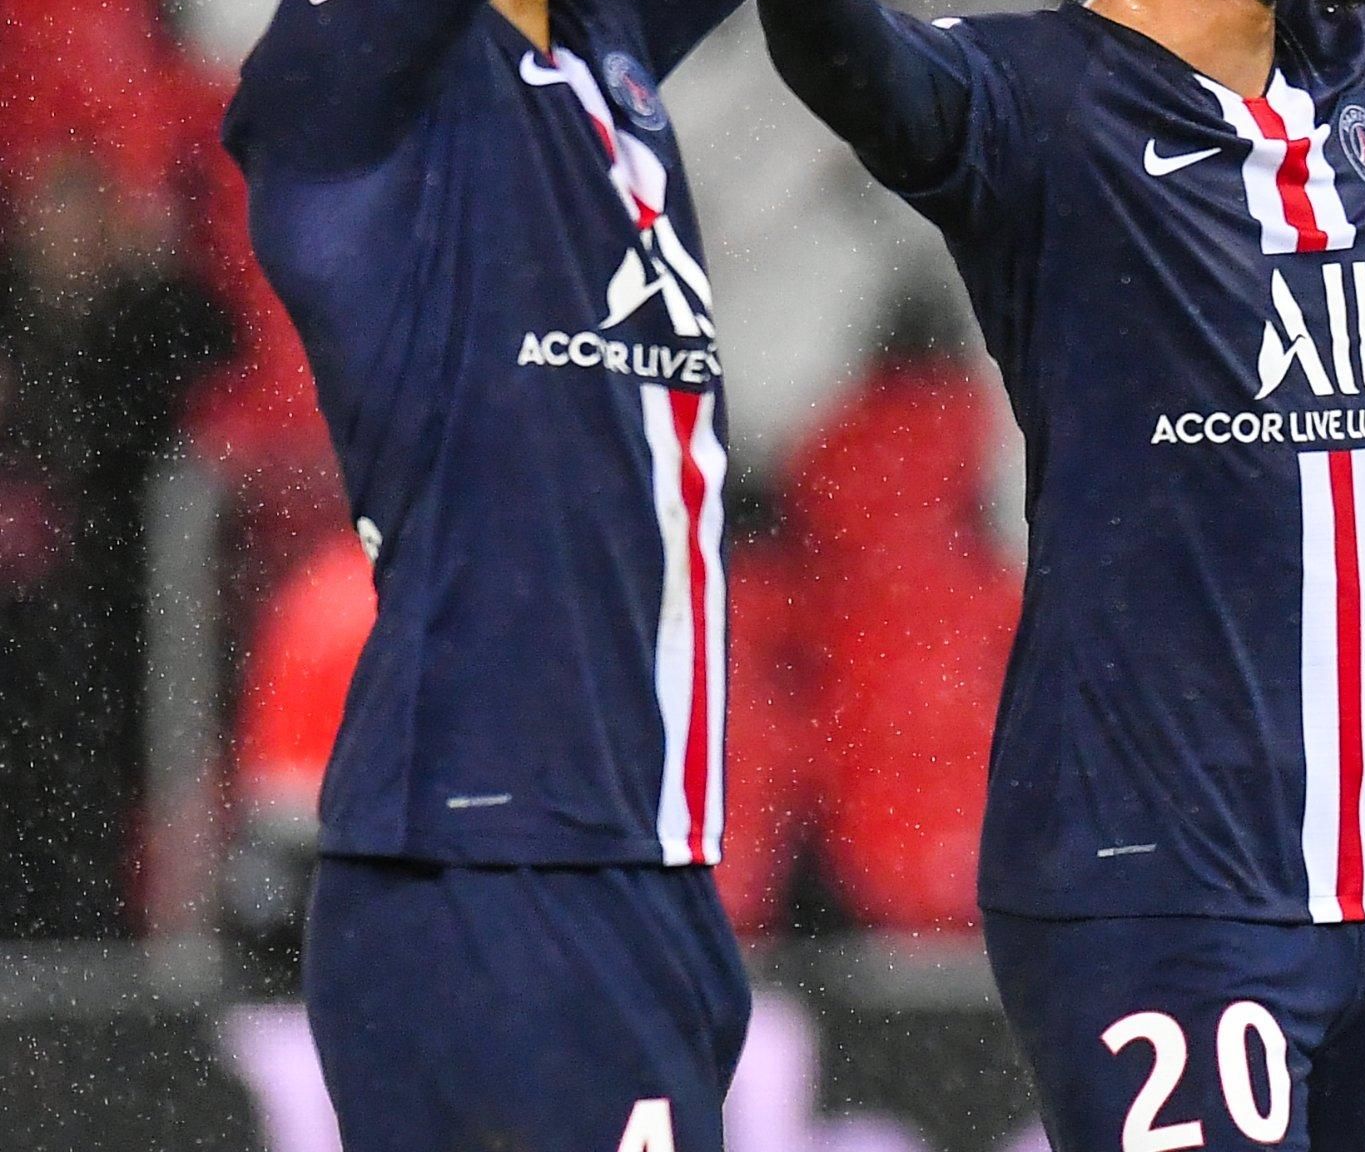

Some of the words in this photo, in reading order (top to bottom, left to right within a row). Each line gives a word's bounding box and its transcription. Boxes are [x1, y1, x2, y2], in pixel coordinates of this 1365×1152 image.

[517, 330, 631, 376] ACCR
[633, 343, 710, 384] LIVE
[1150, 412, 1285, 445] ACCOR
[1290, 409, 1345, 442] LIVE
[1099, 999, 1292, 1152] 20
